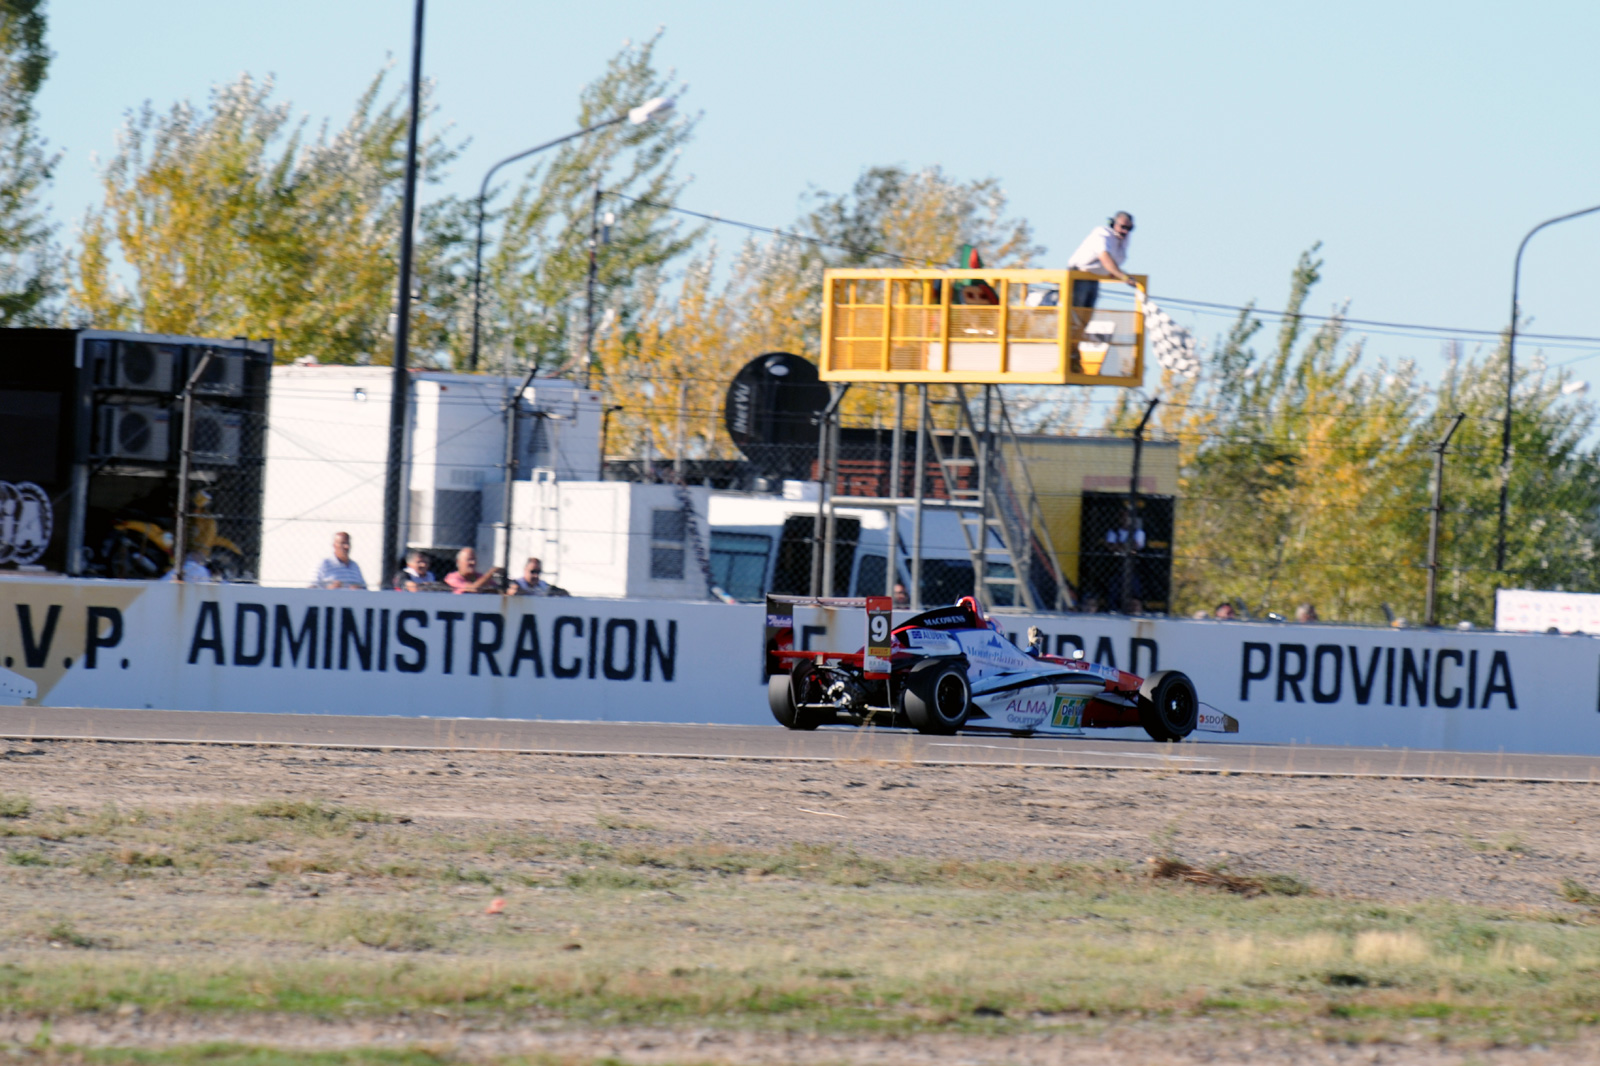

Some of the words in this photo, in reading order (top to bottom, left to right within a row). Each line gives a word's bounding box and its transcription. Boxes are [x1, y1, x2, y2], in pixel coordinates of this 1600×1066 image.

[870, 615, 889, 643] 9
[187, 601, 676, 681] ADMINISTRACION
[1239, 642, 1518, 710] PROVINCIA
[1005, 699, 1049, 716] ALMA
